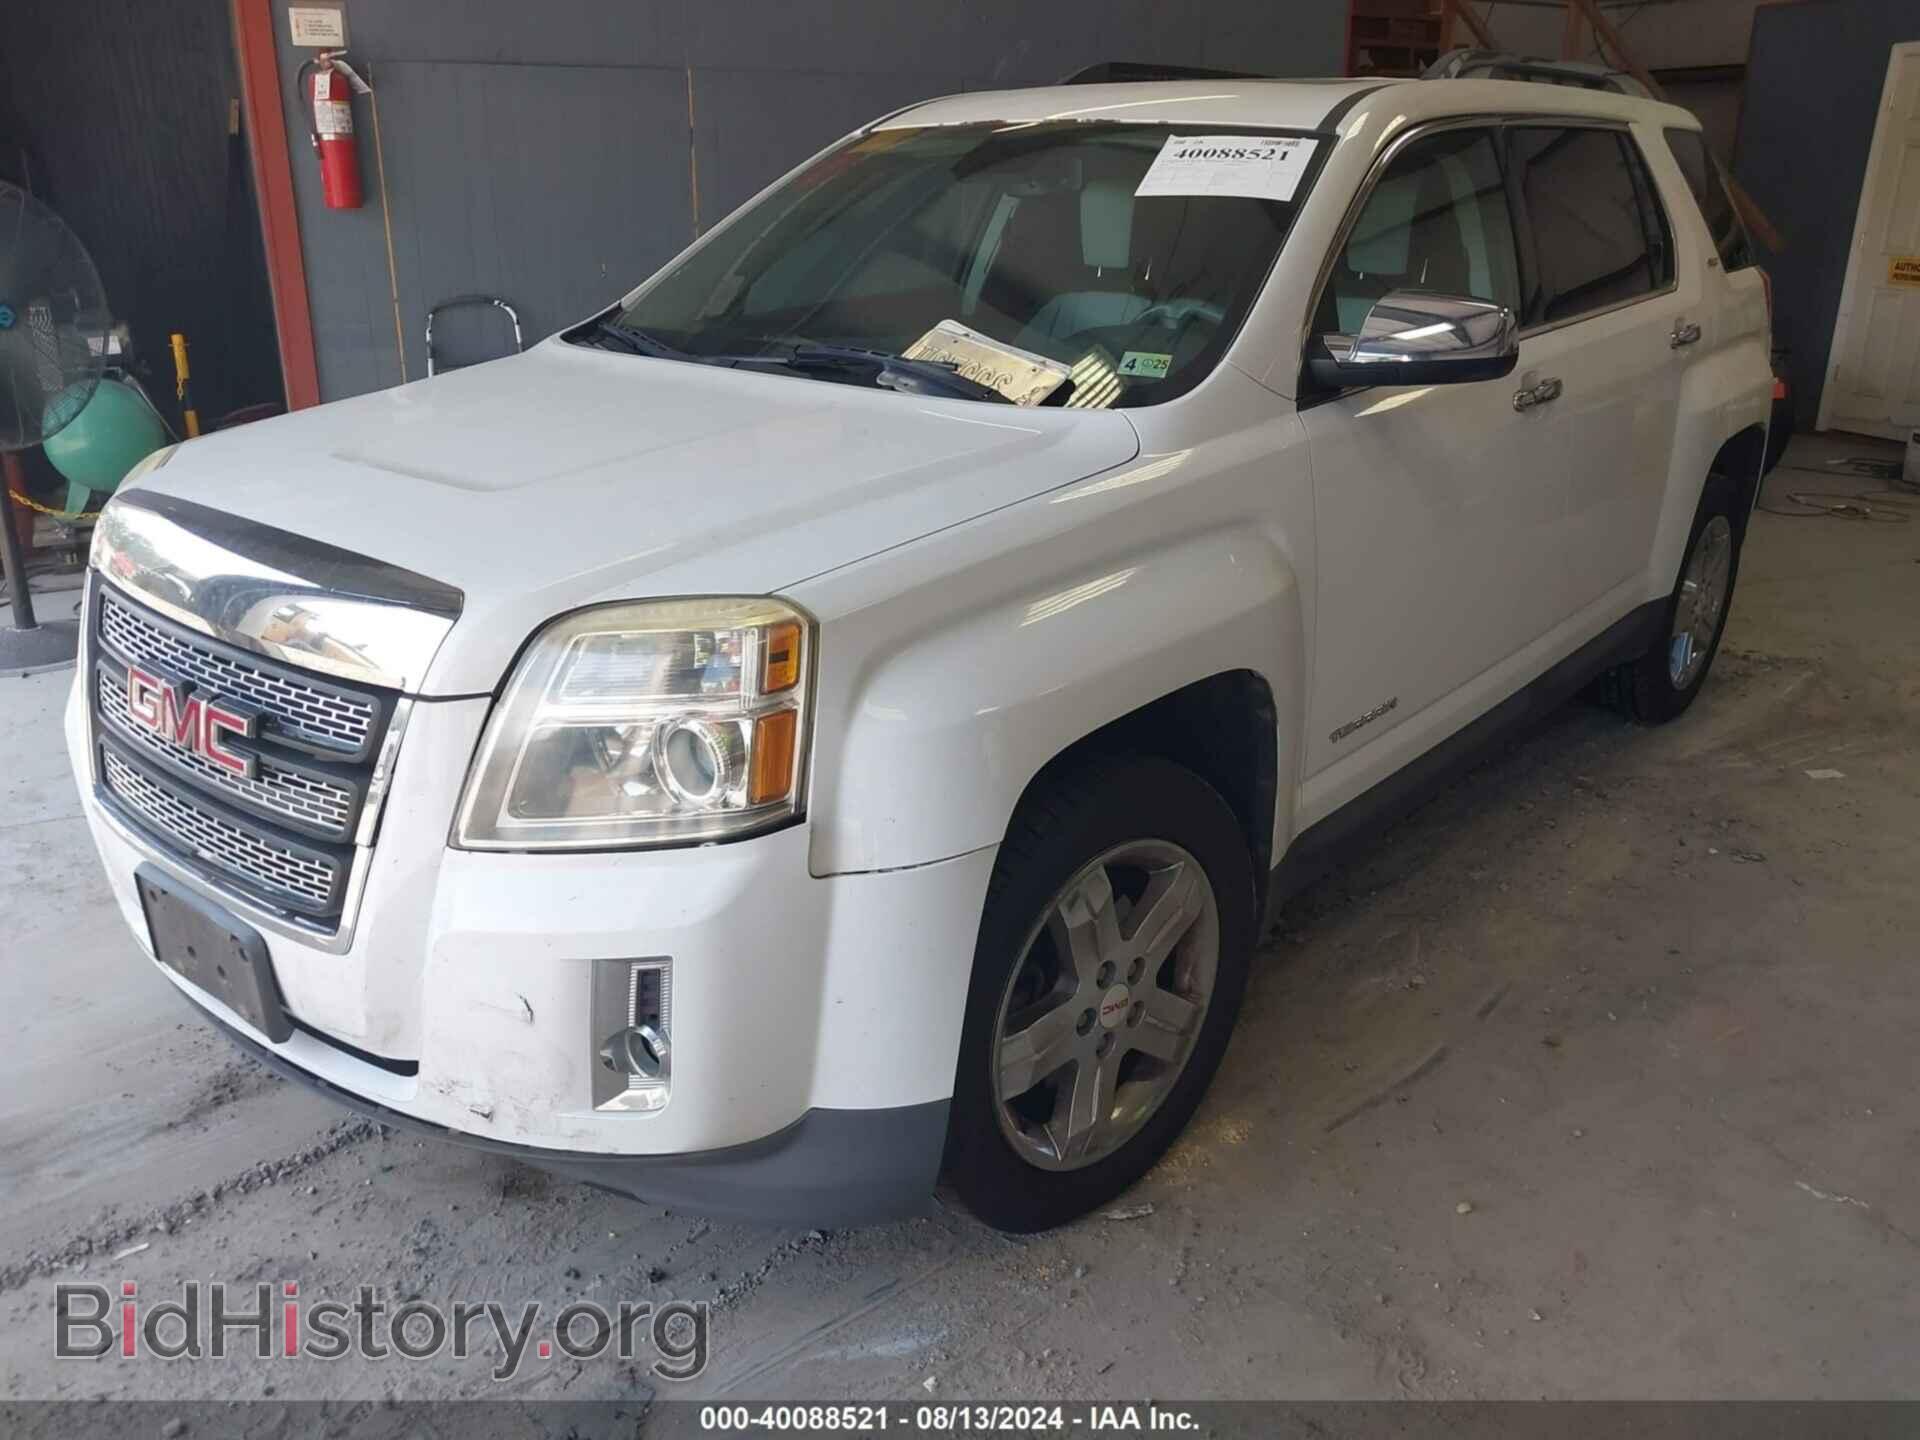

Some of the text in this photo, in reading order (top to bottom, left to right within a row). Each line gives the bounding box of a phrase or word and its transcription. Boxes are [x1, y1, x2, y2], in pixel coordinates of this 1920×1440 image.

[1173, 148, 1290, 161] 40088521
[1124, 358, 1169, 370] 4 25
[128, 664, 253, 777] GMC
